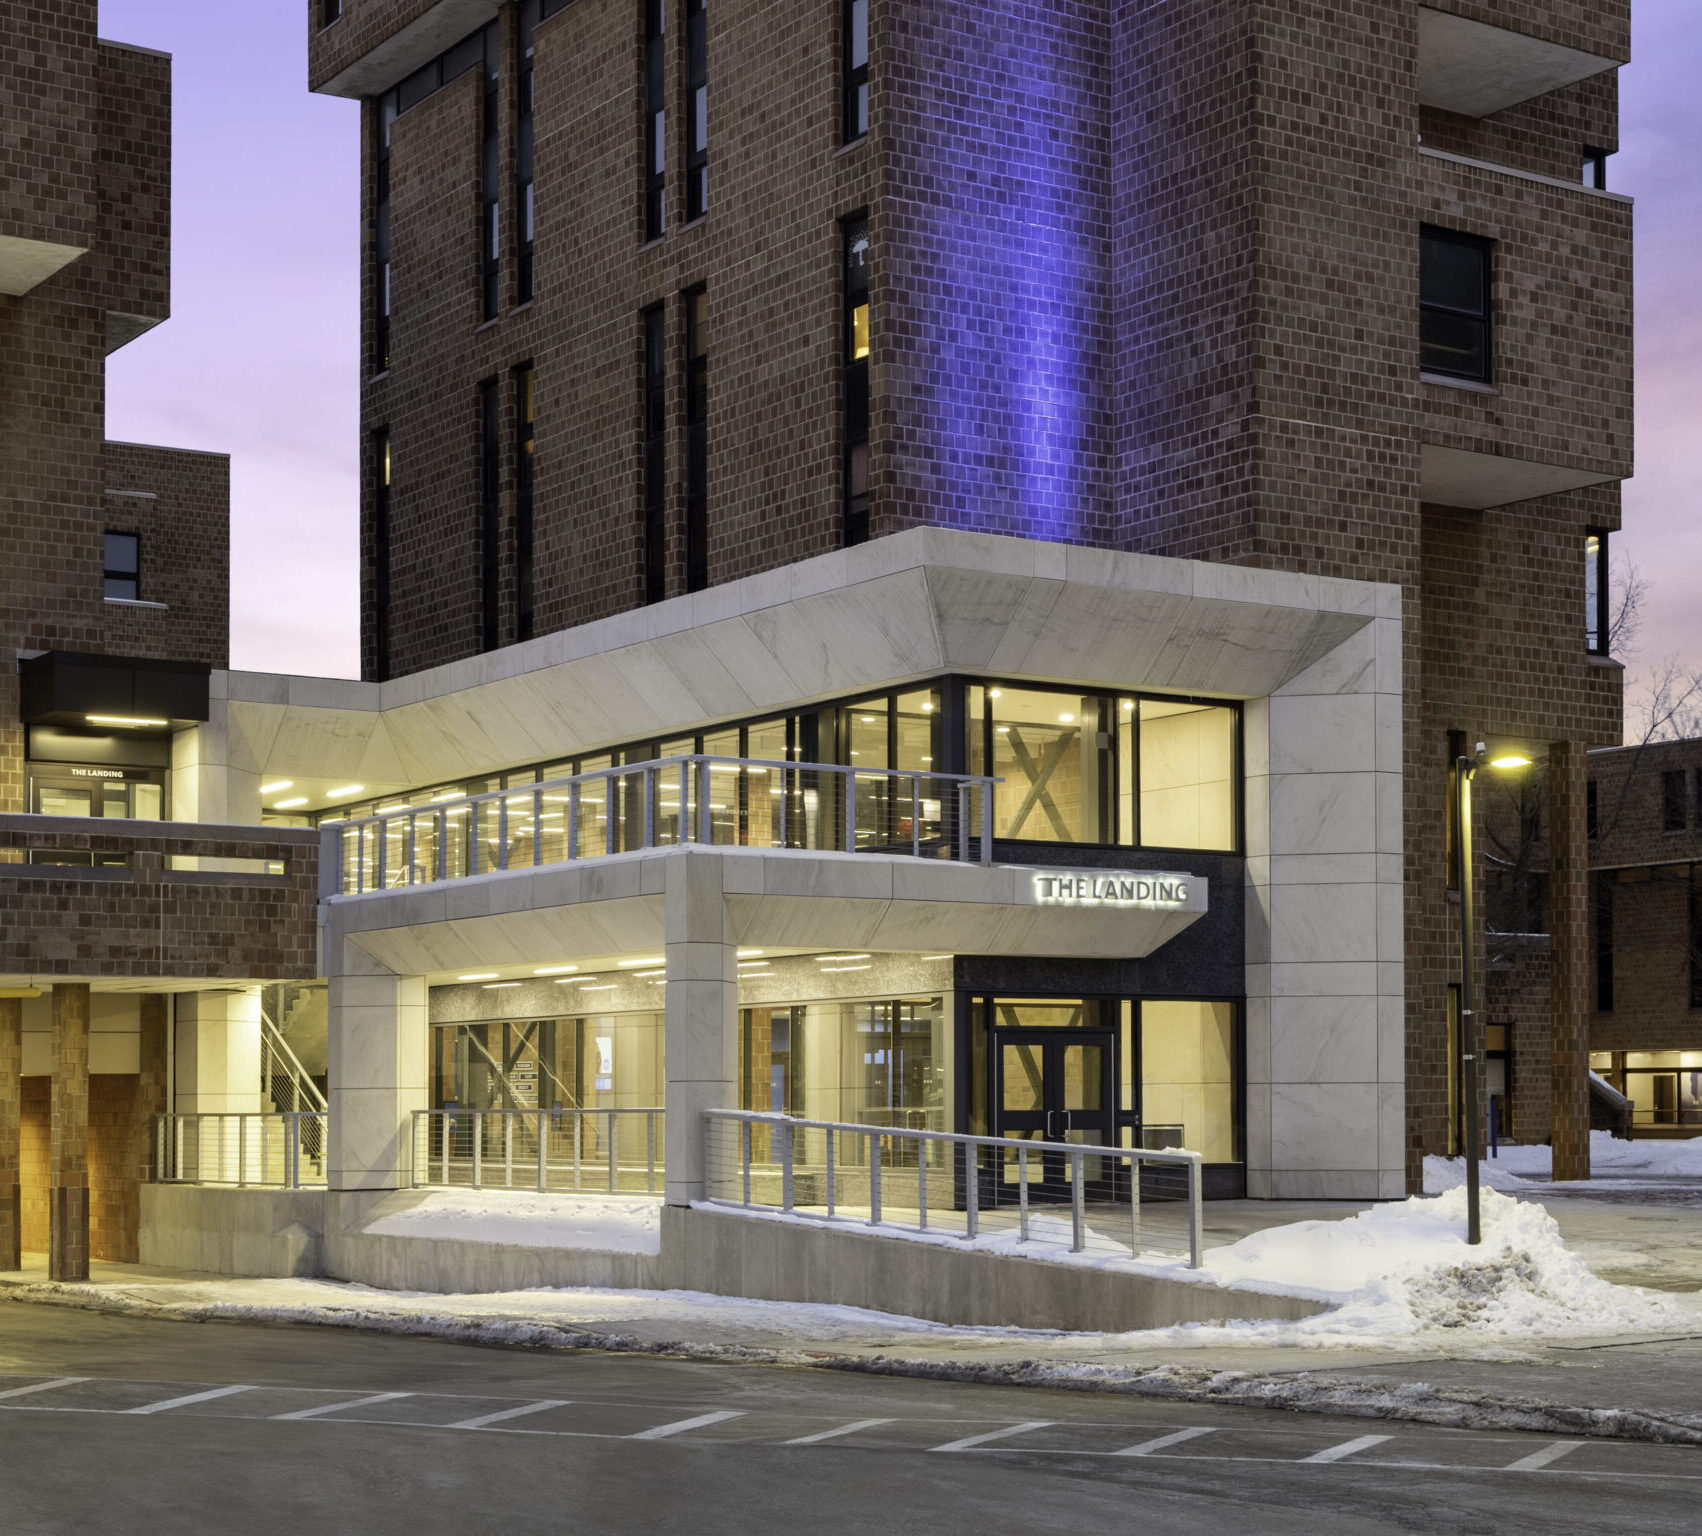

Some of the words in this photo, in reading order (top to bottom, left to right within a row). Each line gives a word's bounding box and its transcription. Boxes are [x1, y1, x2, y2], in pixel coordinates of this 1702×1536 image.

[71, 768, 86, 776] THE
[87, 769, 123, 778] LANDING
[1036, 877, 1086, 898] THE
[1092, 879, 1189, 901] LANDING
